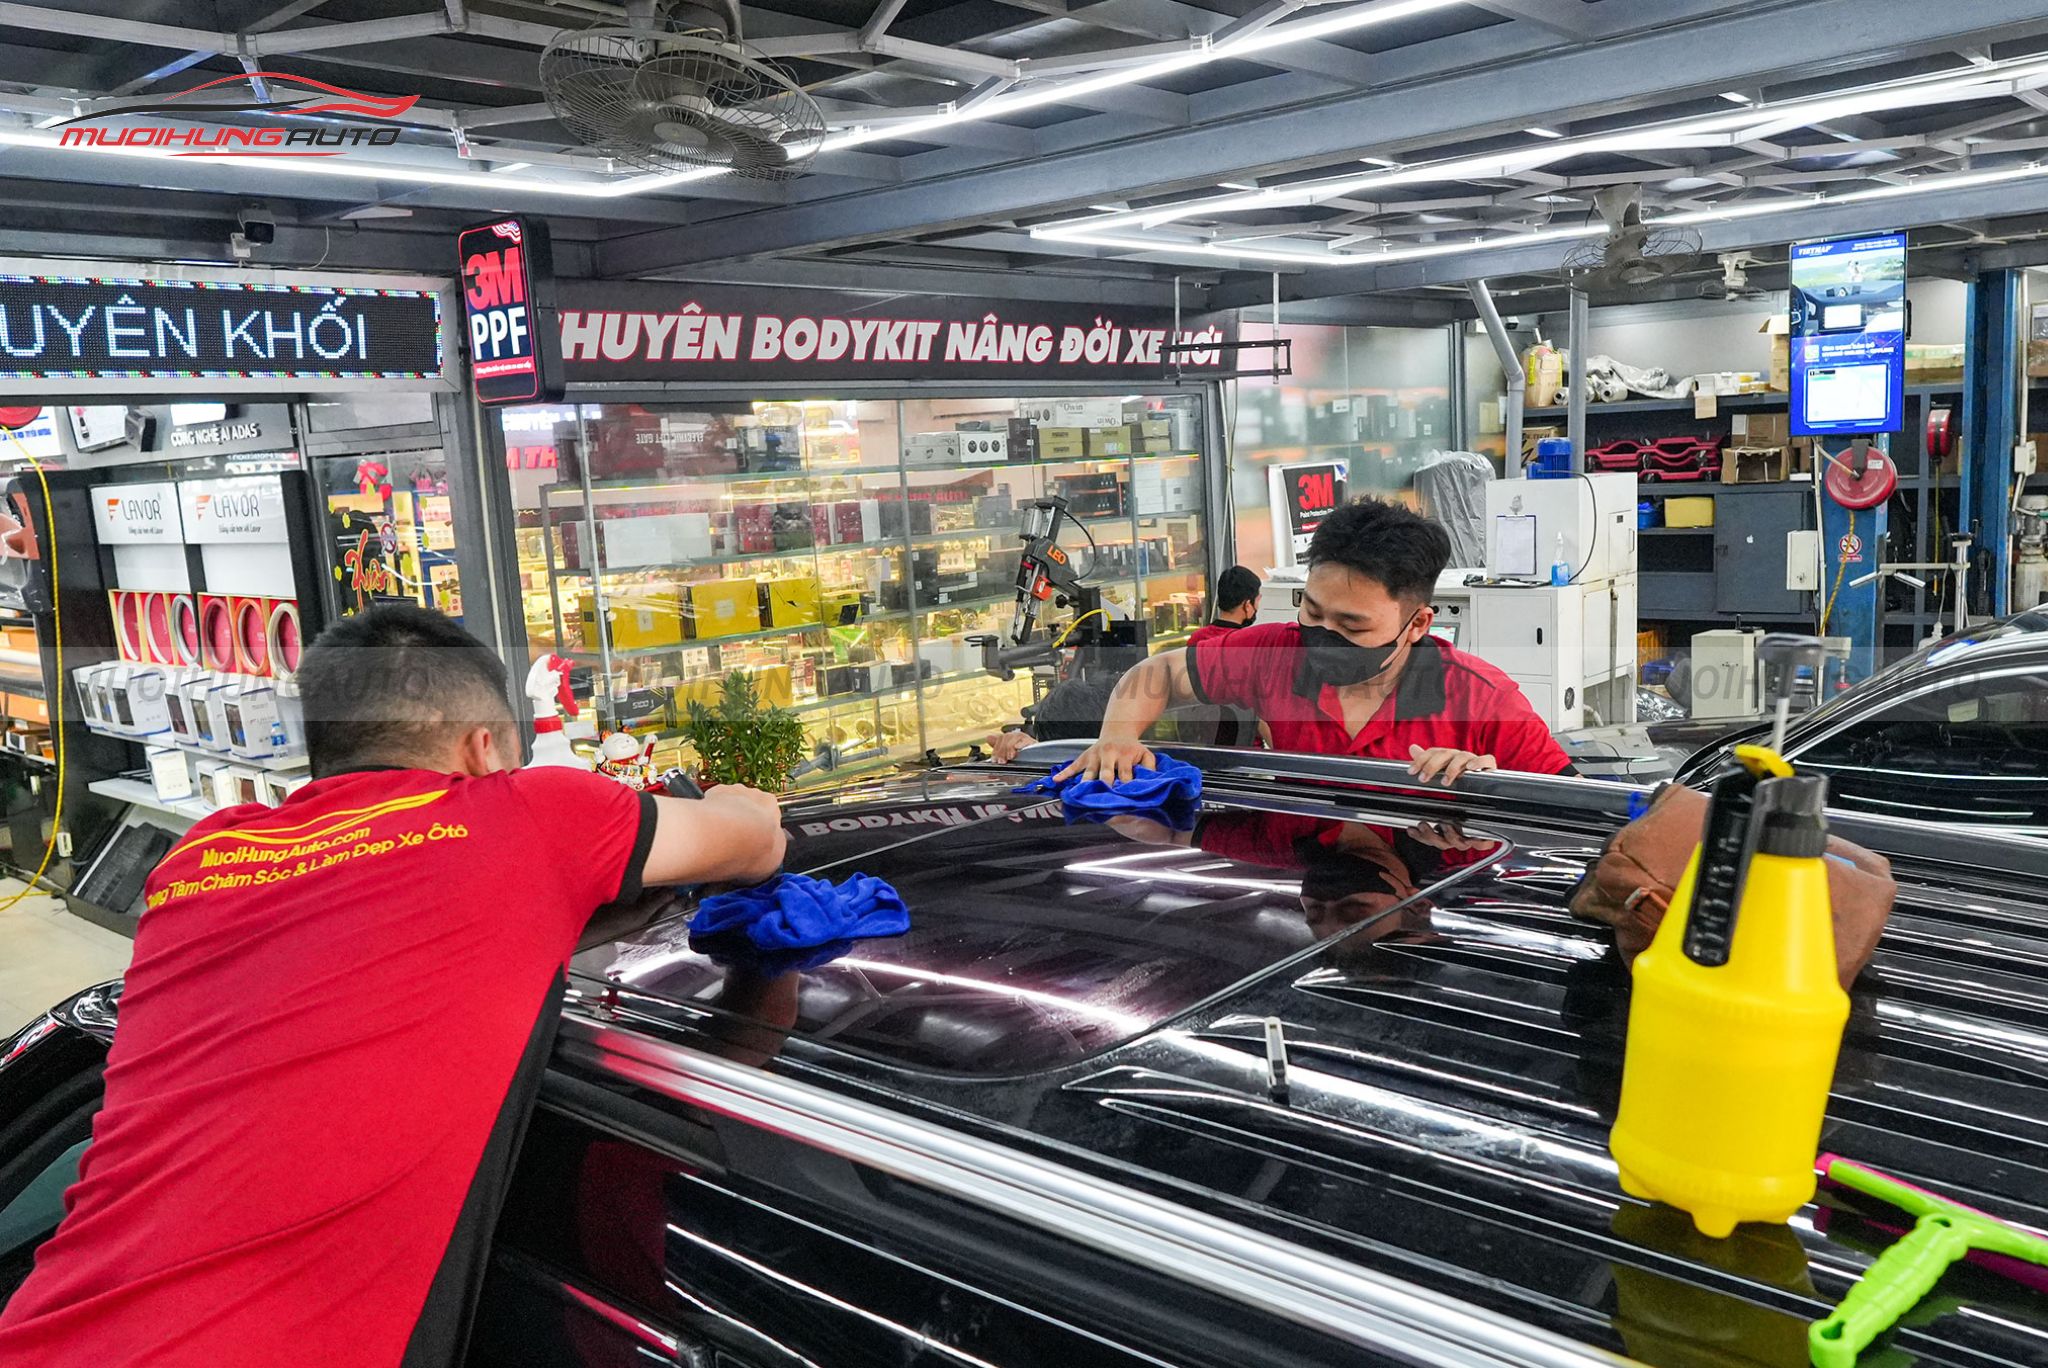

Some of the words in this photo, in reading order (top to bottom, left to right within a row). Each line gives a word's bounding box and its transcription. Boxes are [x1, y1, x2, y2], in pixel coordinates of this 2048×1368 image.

[466, 247, 523, 310] 3M
[0, 294, 197, 357] UYÊN
[223, 297, 366, 359] KHỐI
[470, 306, 527, 360] PPF
[558, 302, 742, 360] HUYÊN
[751, 316, 939, 361] BODYKIT
[945, 313, 1053, 362] NÂNG
[1060, 315, 1120, 364] ĐỜI
[1123, 329, 1165, 365] XE
[171, 428, 195, 447] CÔNG
[195, 424, 220, 446] NGHỆ
[221, 426, 231, 441] AI
[232, 423, 257, 440] ADAS
[121, 499, 162, 520] LAVOR
[214, 494, 260, 518] LAVOR
[1298, 472, 1335, 510] 3M
[1047, 545, 1067, 565] LEO
[169, 880, 200, 898] Tâm
[200, 872, 252, 891] Chăm
[254, 867, 291, 885] Sóc
[293, 862, 307, 877] &
[309, 851, 350, 871] Làm
[352, 839, 395, 857] Đẹp
[397, 831, 425, 848] Xe
[428, 823, 468, 841] Ôtô
[200, 826, 371, 869] MuoiHungAuto.com
